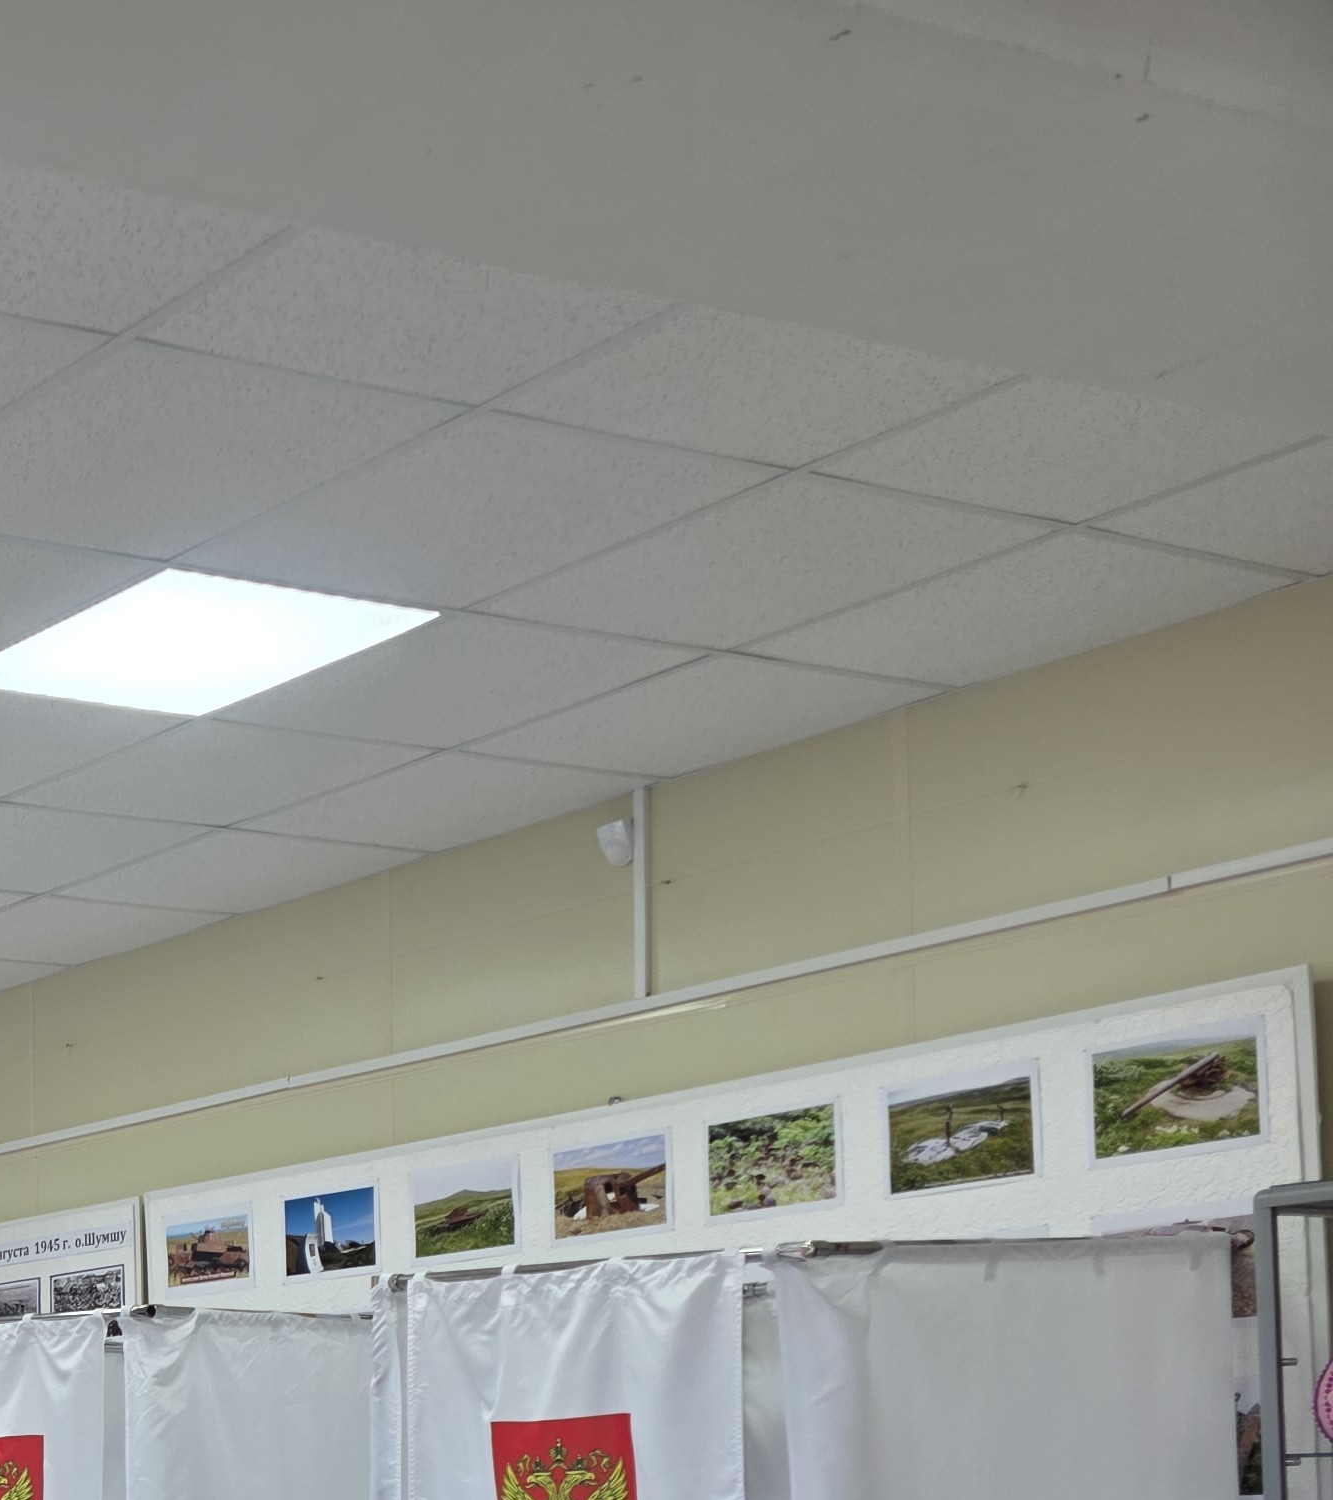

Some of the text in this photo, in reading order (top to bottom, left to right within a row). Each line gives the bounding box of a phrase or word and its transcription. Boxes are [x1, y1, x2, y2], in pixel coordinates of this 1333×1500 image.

[34, 1237, 60, 1255] 1945
[62, 1241, 71, 1250] г.
[74, 1229, 127, 1249] о.Шумшу
